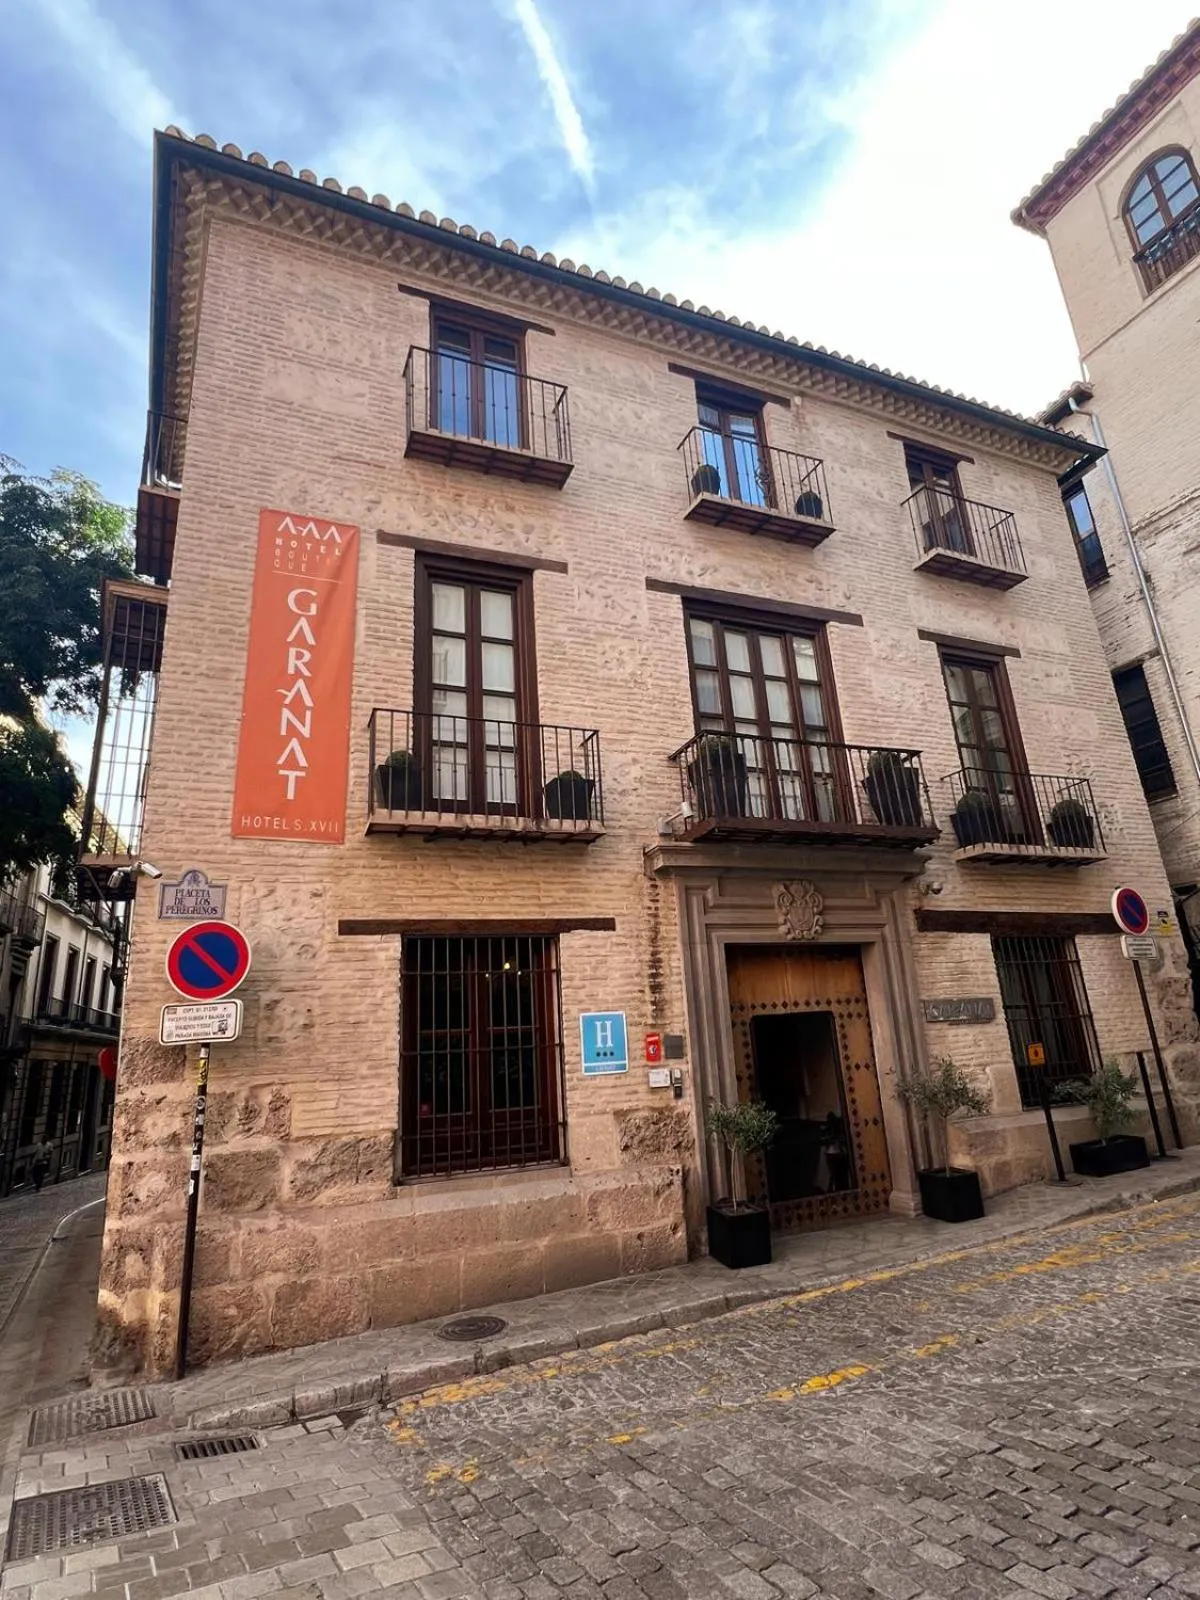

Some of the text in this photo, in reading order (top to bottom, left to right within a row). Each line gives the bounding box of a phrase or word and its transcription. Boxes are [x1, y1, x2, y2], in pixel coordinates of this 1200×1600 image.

[275, 537, 341, 556] HOTEL
[276, 588, 319, 800] GARANAT
[241, 815, 290, 830] HOTEL
[175, 888, 211, 898] PLACETA
[174, 897, 211, 906] DE LOS
[165, 904, 219, 915] PEREGRINOS
[594, 1020, 614, 1048] H
